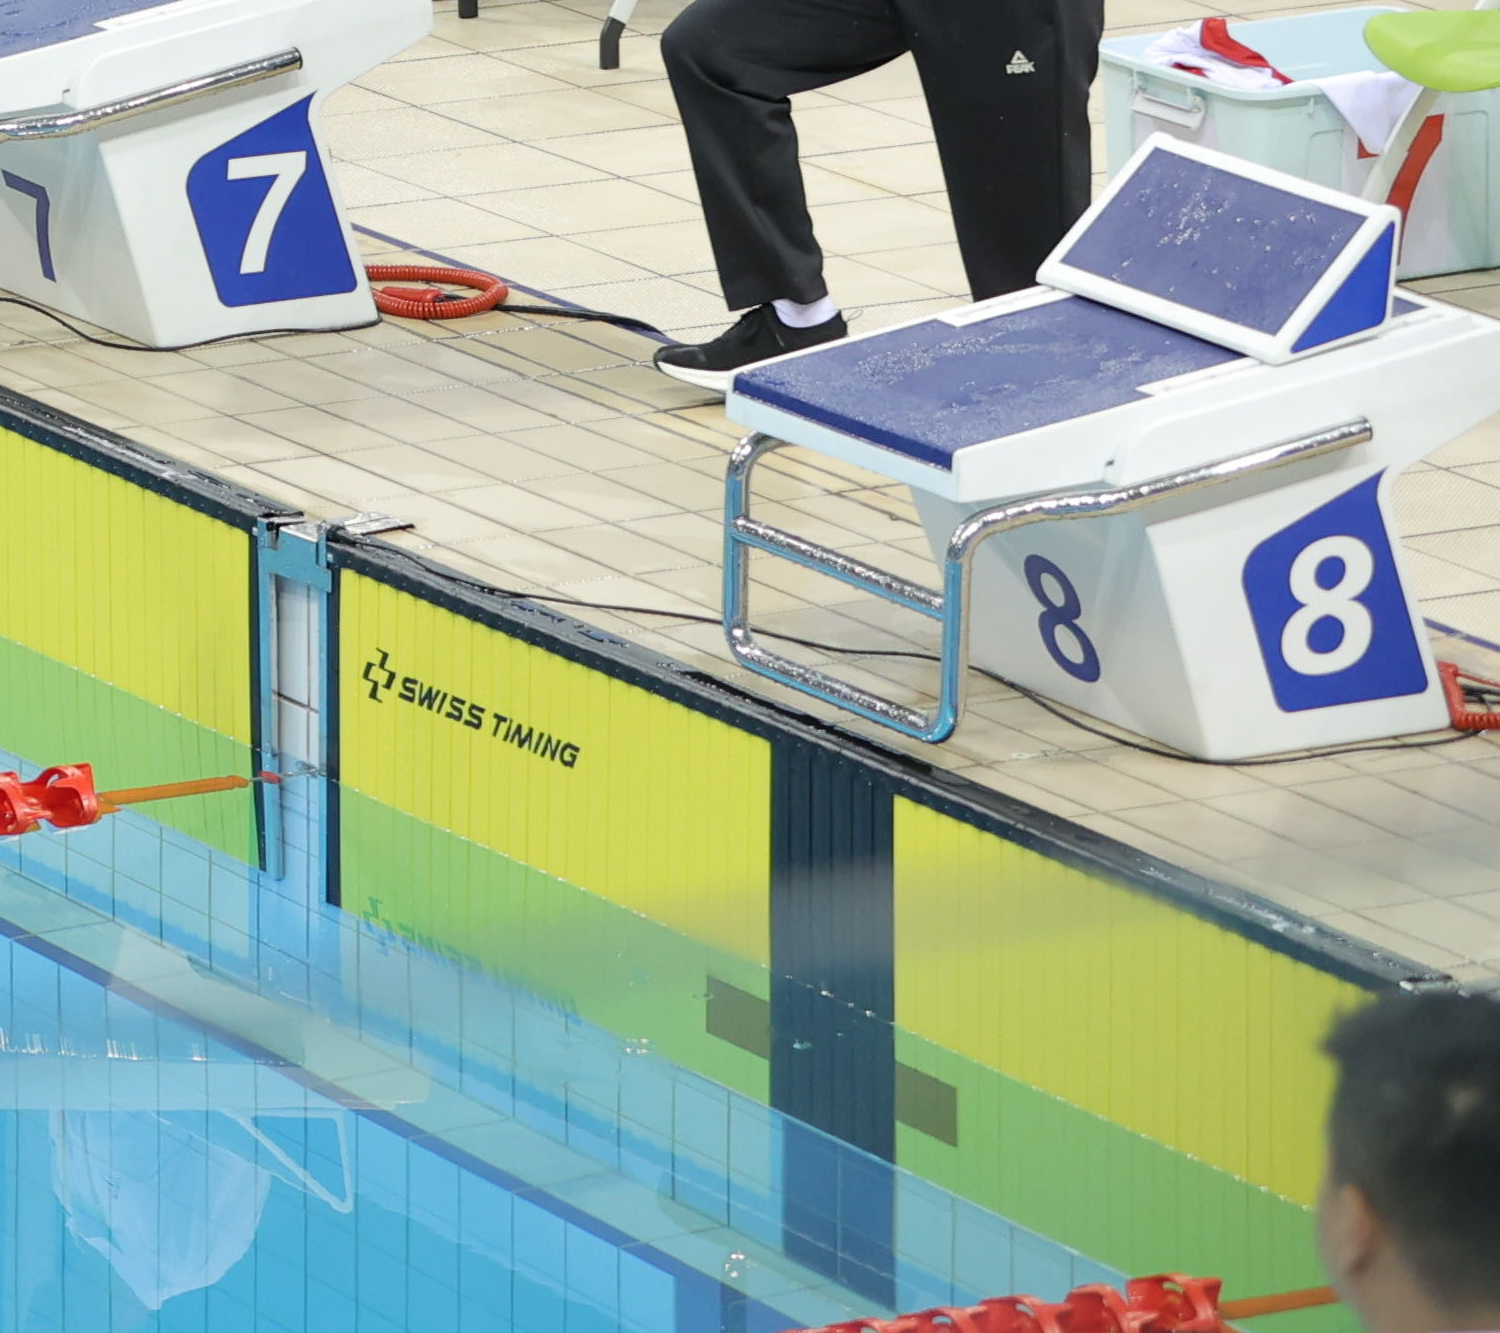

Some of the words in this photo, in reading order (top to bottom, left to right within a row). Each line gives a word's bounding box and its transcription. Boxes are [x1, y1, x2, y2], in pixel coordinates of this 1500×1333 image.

[0, 169, 57, 283] 7
[225, 150, 307, 274] 7
[1023, 553, 1101, 683] 8
[1279, 533, 1375, 677] 8
[397, 676, 485, 732] SWISS
[490, 711, 581, 771] TIMING
